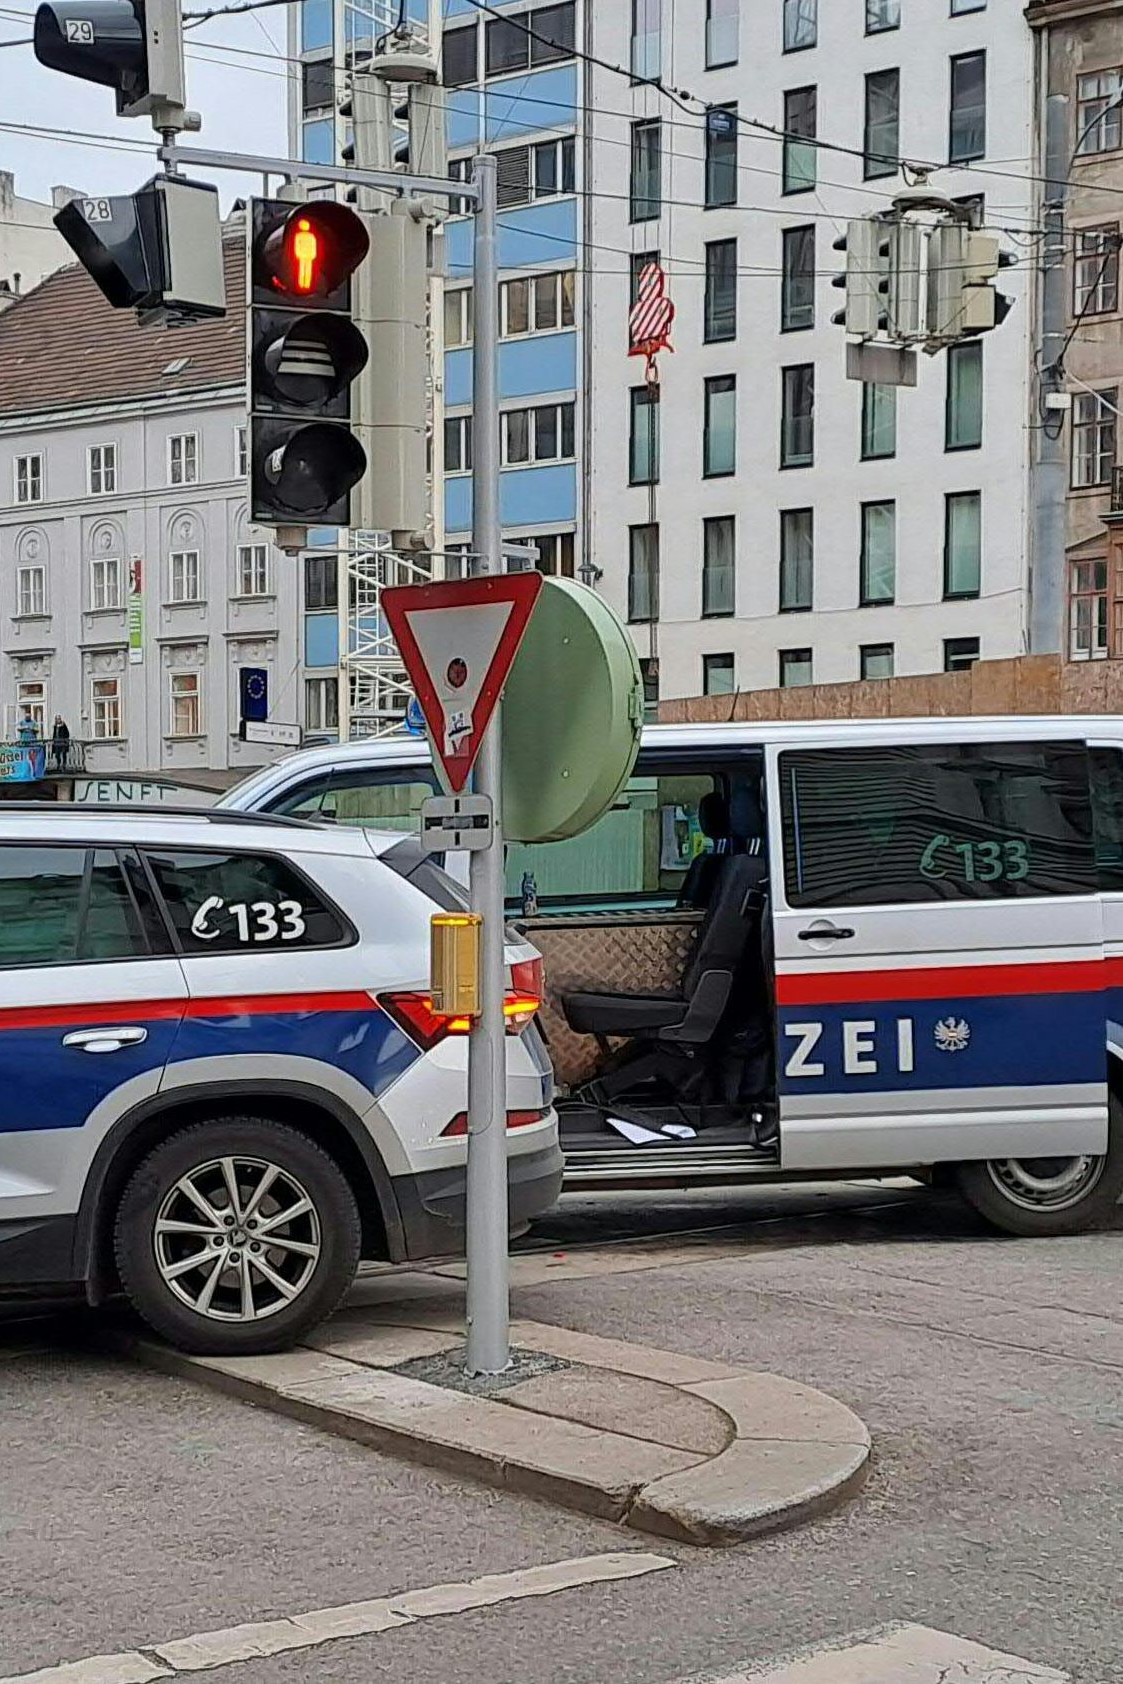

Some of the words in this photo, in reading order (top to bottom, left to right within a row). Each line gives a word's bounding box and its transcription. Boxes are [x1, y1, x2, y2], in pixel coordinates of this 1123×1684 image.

[68, 22, 92, 41] 29
[87, 201, 110, 220] 28
[956, 840, 1029, 881] 133
[229, 900, 306, 941] 133
[785, 1018, 913, 1076] ZEI
